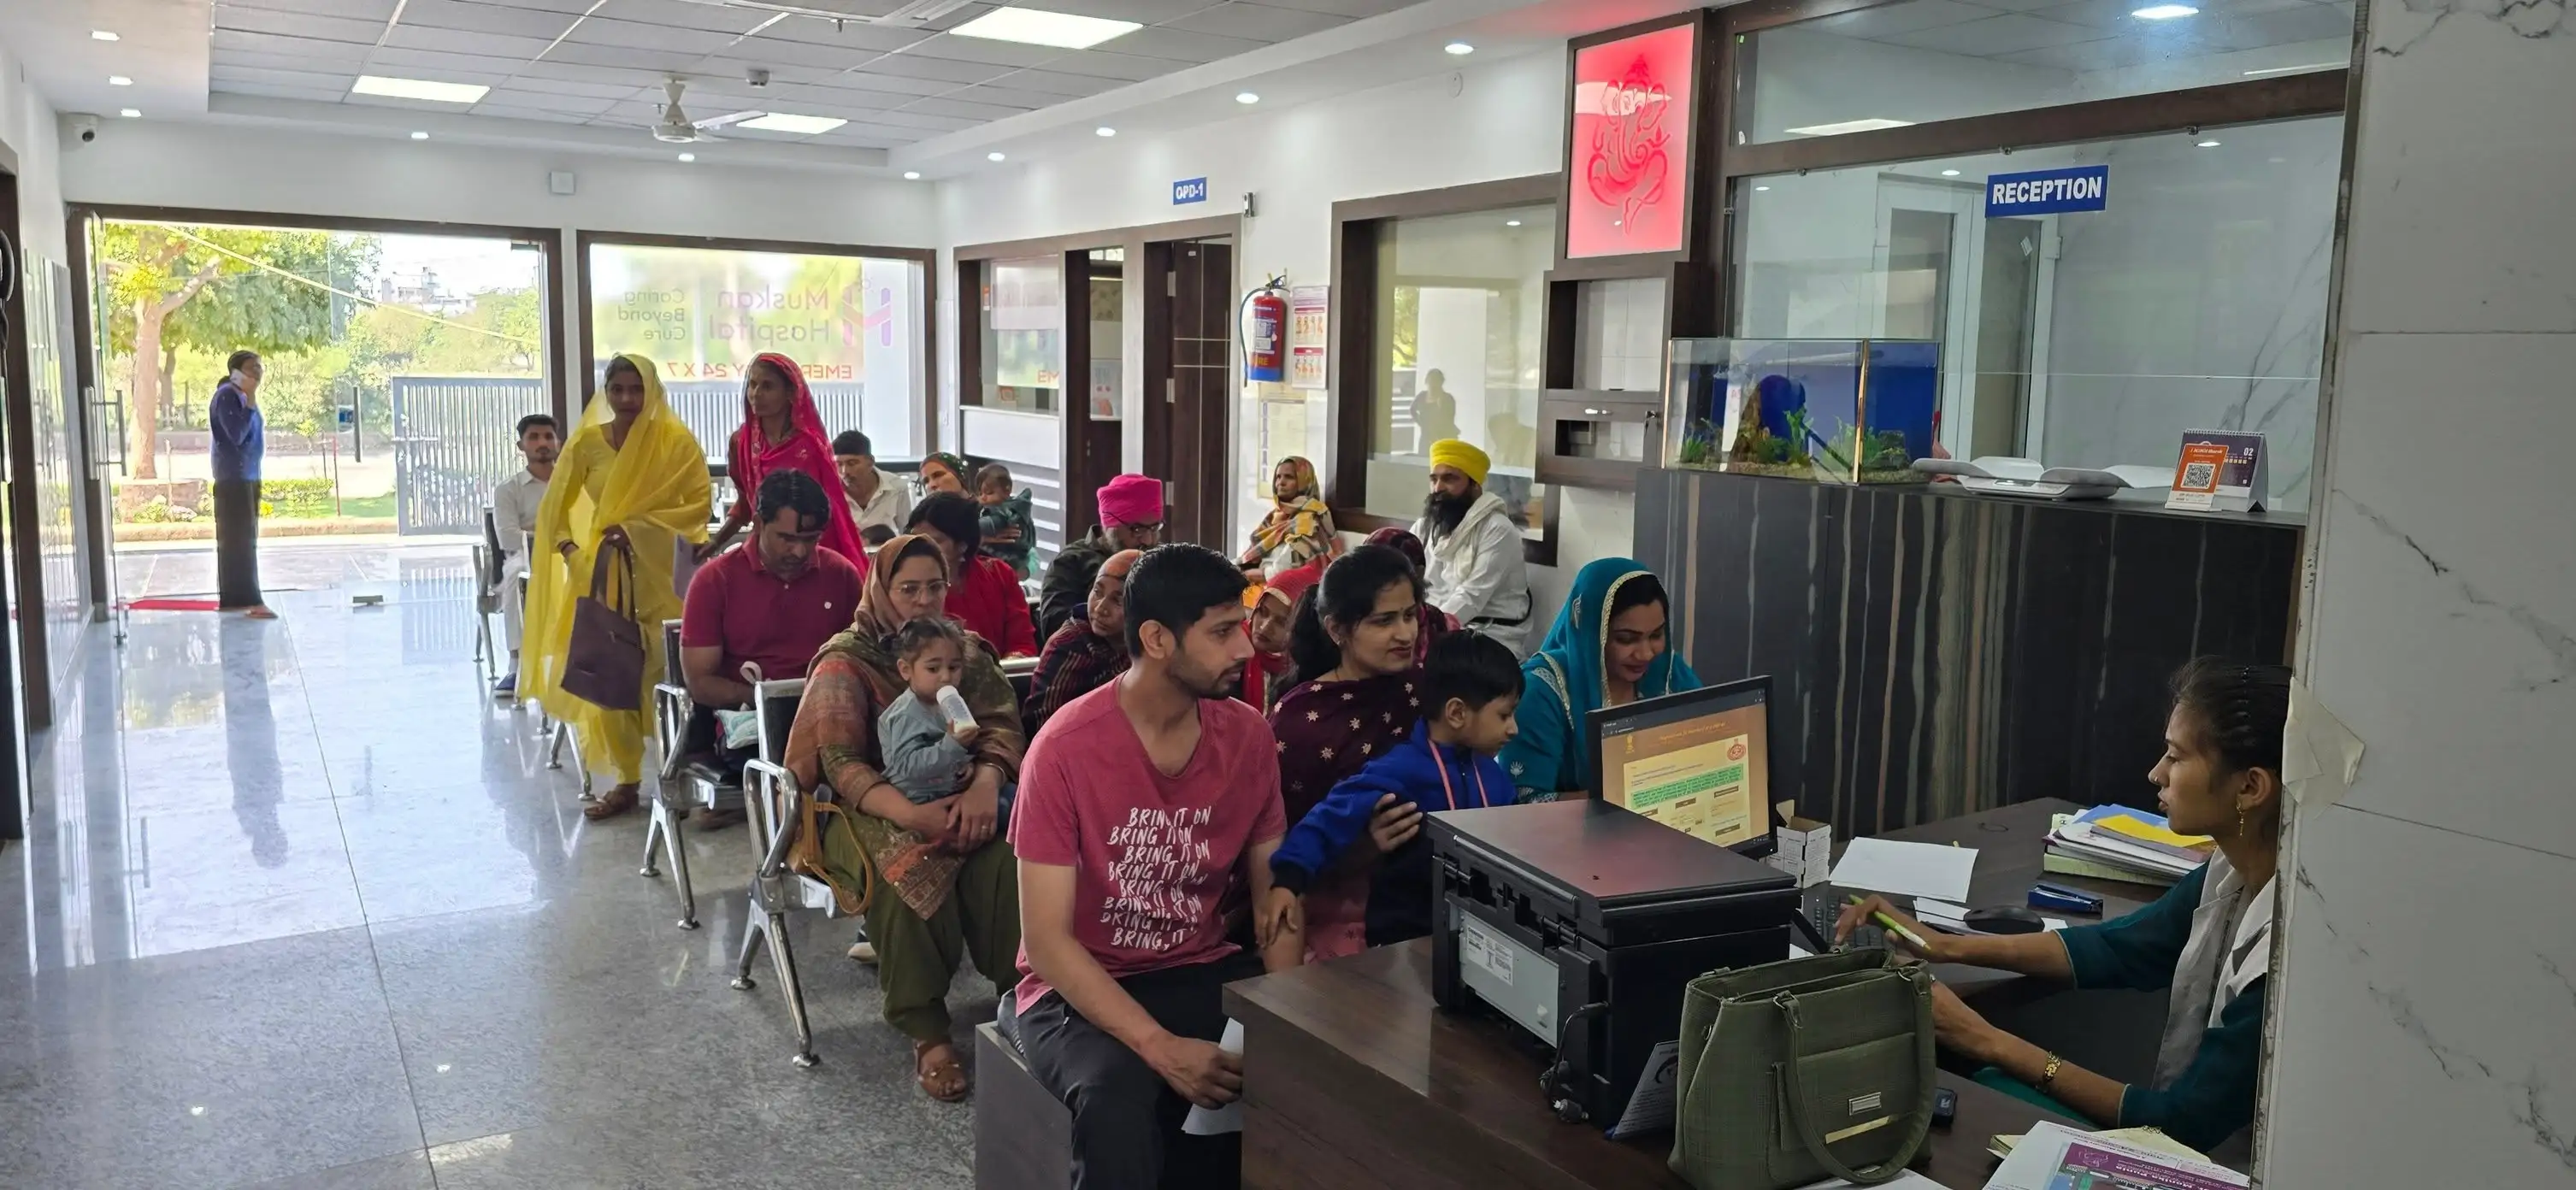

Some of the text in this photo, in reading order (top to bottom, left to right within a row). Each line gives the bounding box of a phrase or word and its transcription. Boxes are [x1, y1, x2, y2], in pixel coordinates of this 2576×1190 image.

[1176, 182, 1204, 199] OPD-1
[1992, 176, 2102, 204] RECEPTION
[2243, 447, 2255, 457] 02
[1173, 807, 1188, 828] IT
[1194, 805, 1212, 826] ON
[1106, 826, 1158, 847] BRING
[1178, 824, 1194, 846] ON
[1122, 845, 1173, 866] BRING
[1194, 839, 1211, 860] ON
[1108, 861, 1154, 881] BRING
[1161, 860, 1179, 880] IT
[1180, 859, 1200, 881] ON
[1102, 896, 1152, 914] BRING
[1111, 927, 1163, 951] BRING
[1172, 928, 1188, 945] IT
